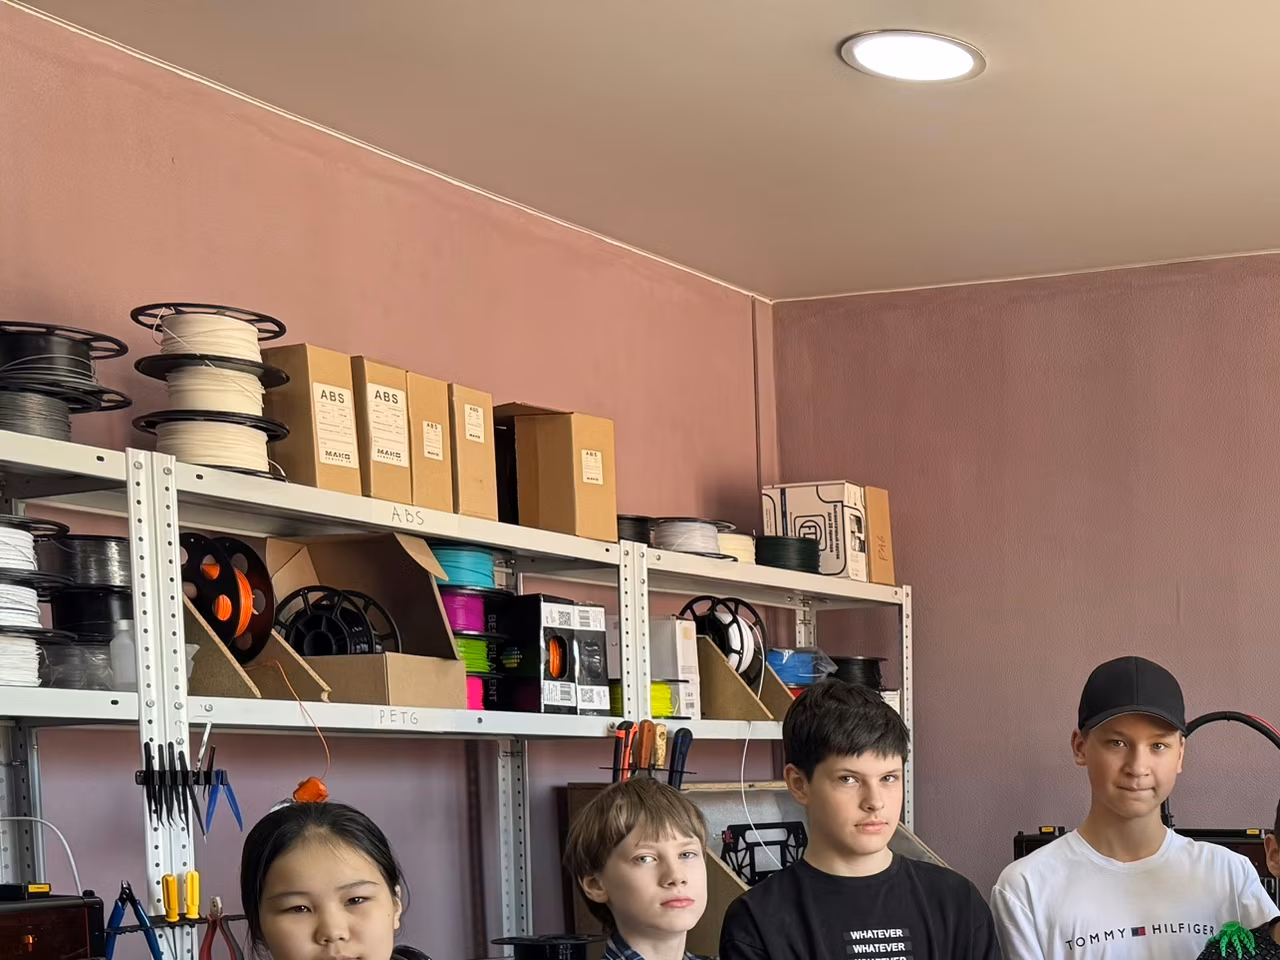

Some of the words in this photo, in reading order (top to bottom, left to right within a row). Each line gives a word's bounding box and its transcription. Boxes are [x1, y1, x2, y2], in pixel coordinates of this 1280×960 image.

[320, 389, 345, 404] ABS
[374, 390, 399, 405] ABS
[426, 422, 438, 430] ABS
[391, 506, 425, 525] ABS
[380, 709, 419, 724] PETG
[850, 929, 904, 940] WHATEVER
[1065, 928, 1126, 950] TOMMY
[1152, 923, 1215, 936] HILFIGER
[853, 942, 906, 953] WHATEVER
